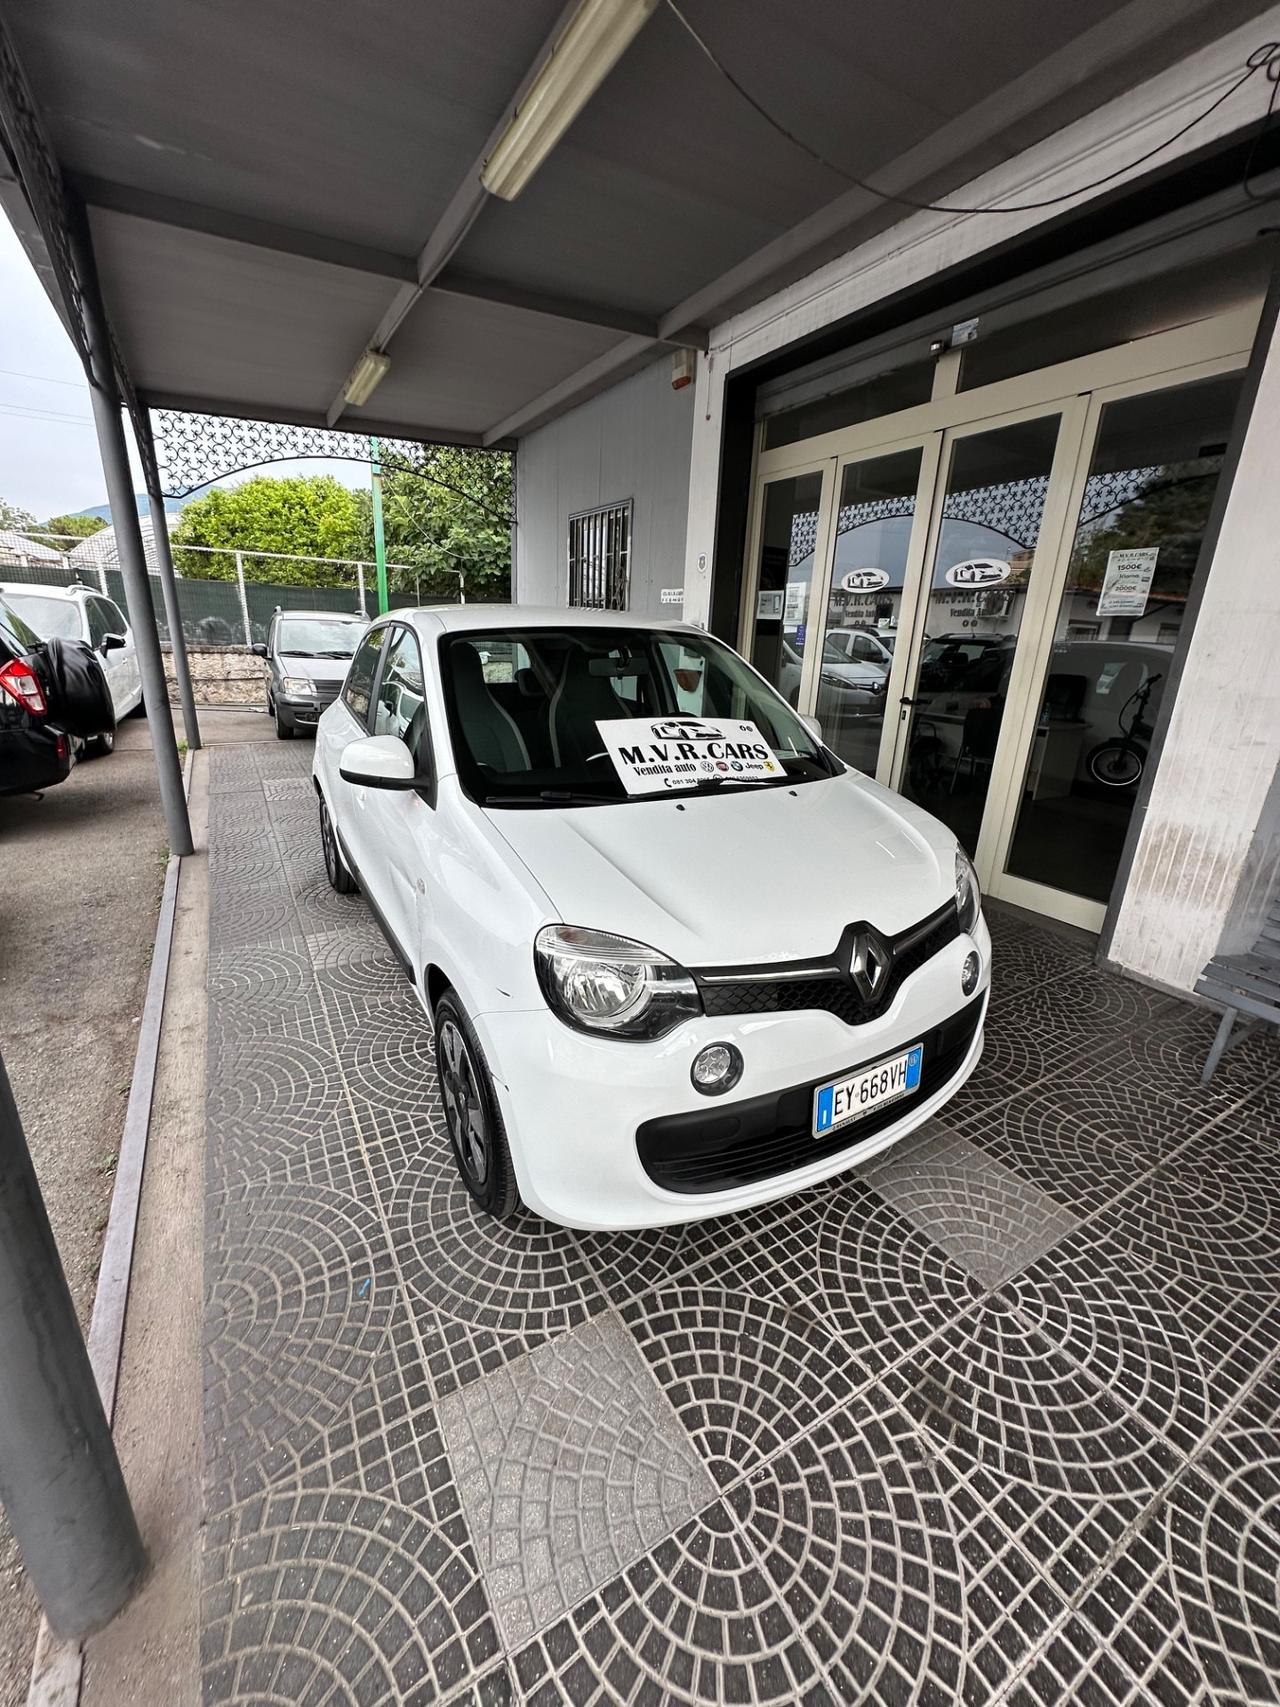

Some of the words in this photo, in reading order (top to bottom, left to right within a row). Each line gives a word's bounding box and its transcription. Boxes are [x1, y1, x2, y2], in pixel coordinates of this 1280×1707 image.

[618, 743, 769, 766] M.V.R.CARS
[633, 764, 674, 777] Vendita
[674, 763, 697, 773] auto
[745, 762, 764, 770] Jeep
[860, 1060, 908, 1104] 668VH
